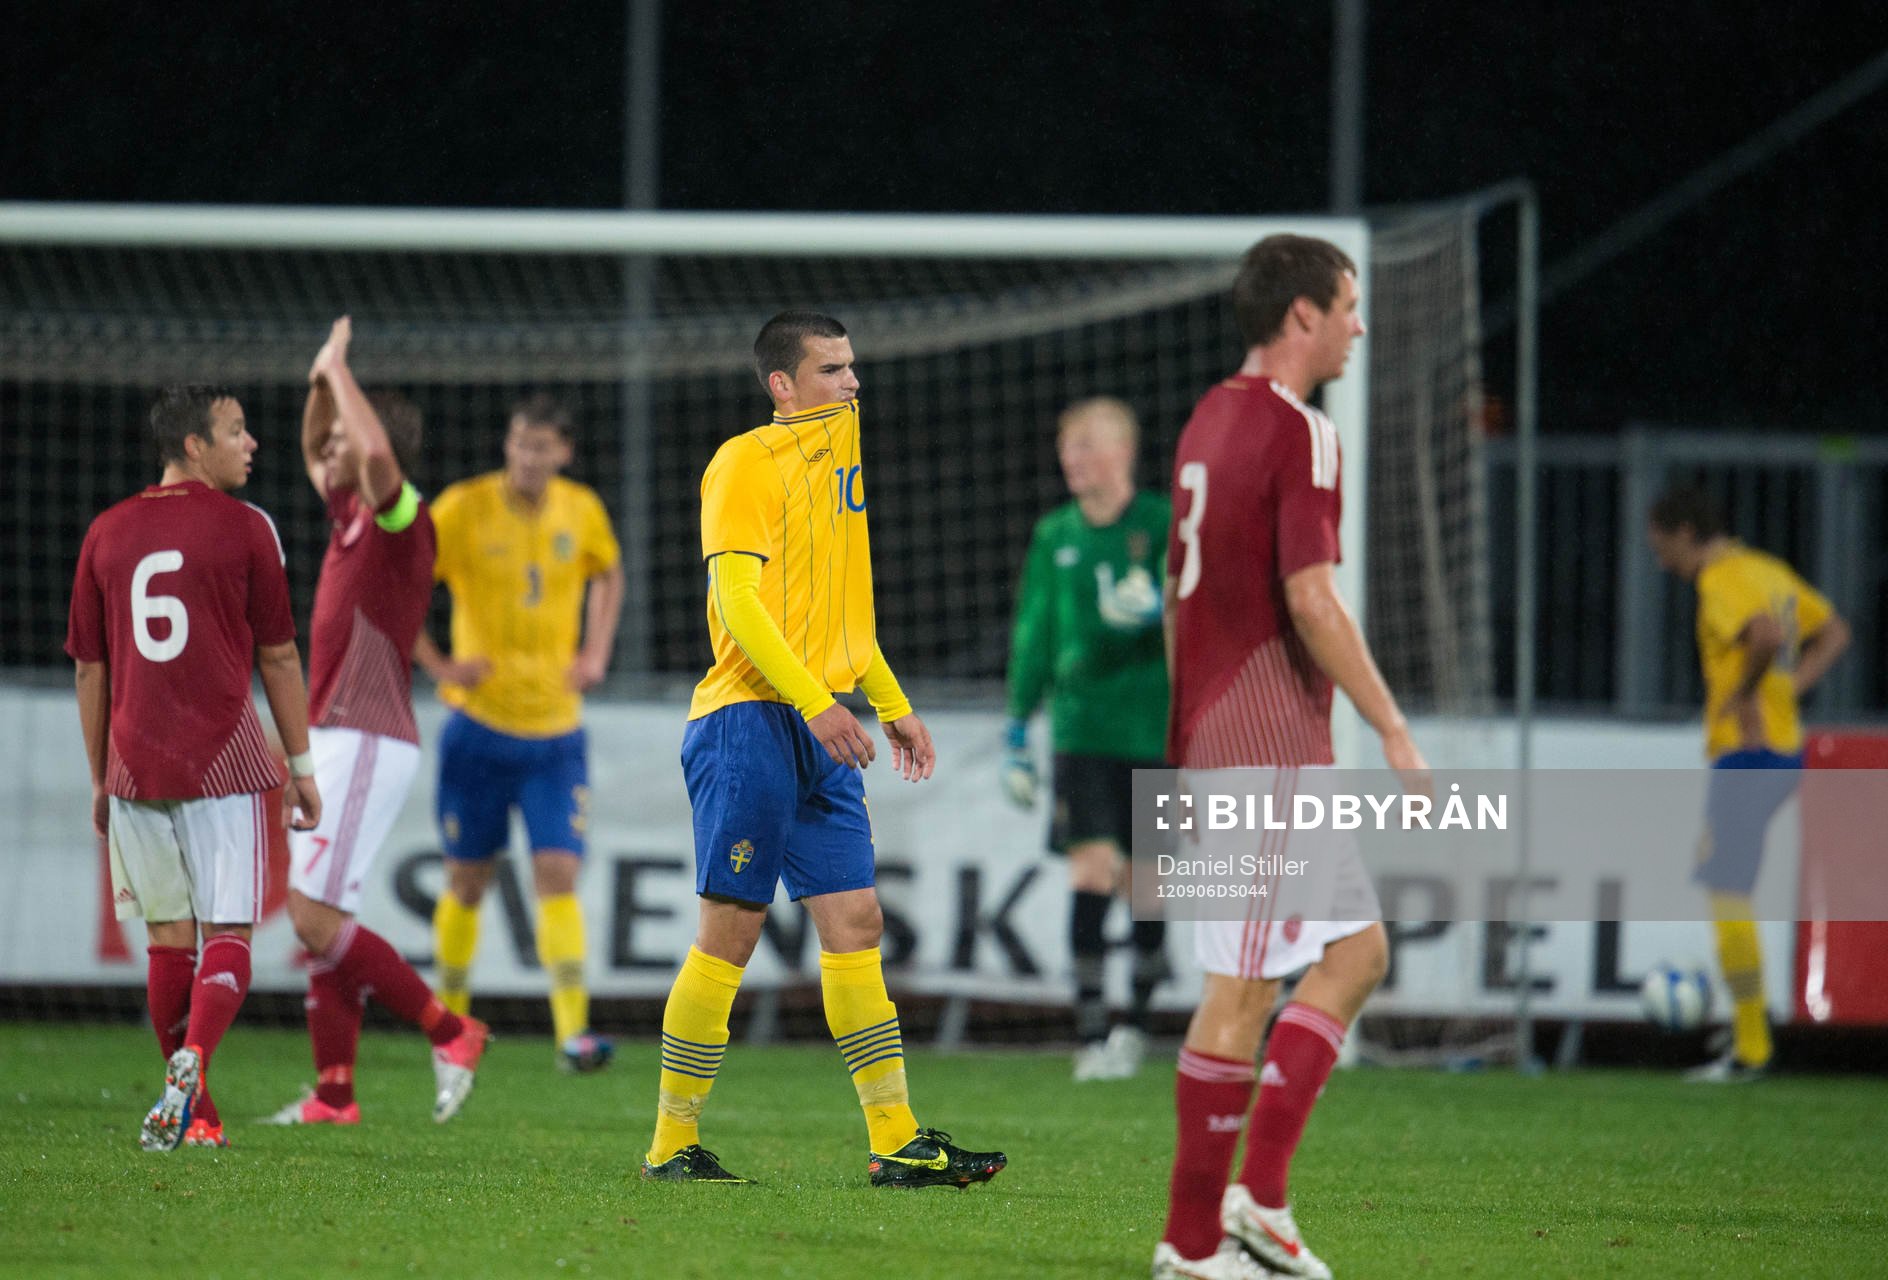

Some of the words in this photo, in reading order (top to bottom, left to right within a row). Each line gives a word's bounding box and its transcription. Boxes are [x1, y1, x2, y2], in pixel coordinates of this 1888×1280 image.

[835, 464, 866, 515] 10
[1178, 462, 1208, 600] 3
[130, 549, 190, 663] 6
[304, 836, 330, 876] 7
[1284, 873, 1650, 994] PEL
